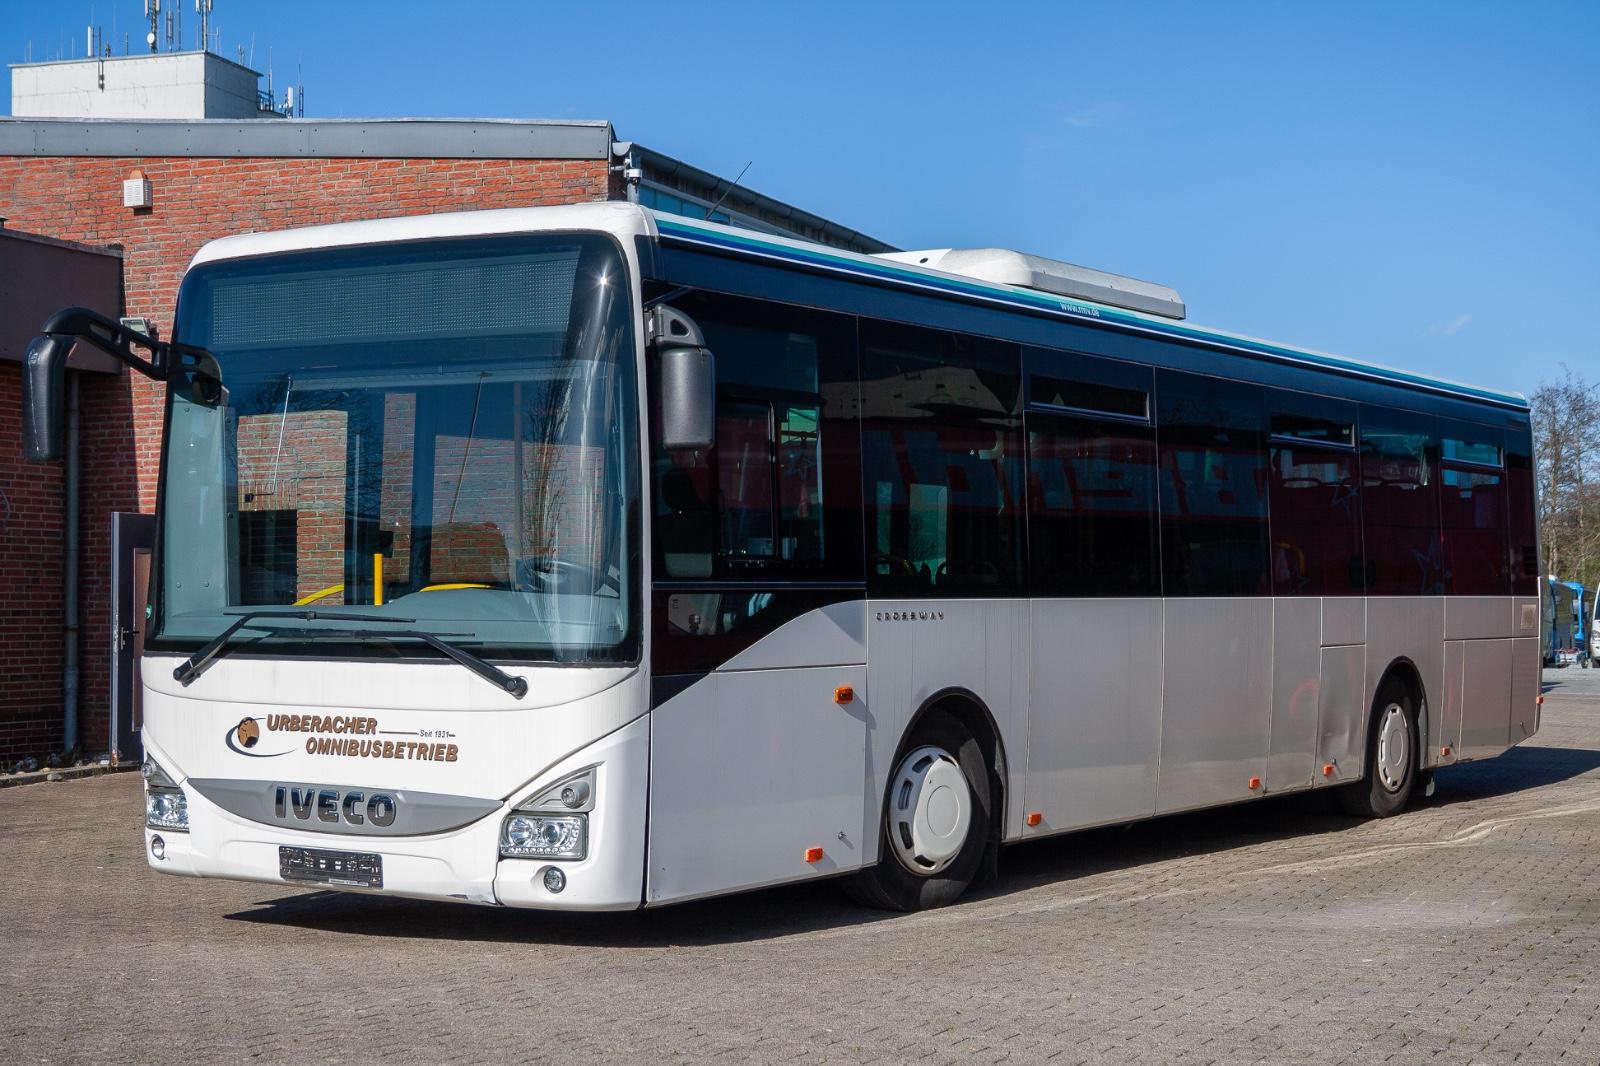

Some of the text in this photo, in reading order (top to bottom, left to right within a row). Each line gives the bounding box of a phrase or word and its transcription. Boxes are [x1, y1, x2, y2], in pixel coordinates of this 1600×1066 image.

[876, 612, 944, 621] CROSSWAY
[267, 714, 378, 735] URBERACHER
[419, 729, 449, 738] Seit 1931
[306, 737, 459, 762] OMNIBUSBETRIEB
[275, 787, 397, 827] IVECO
